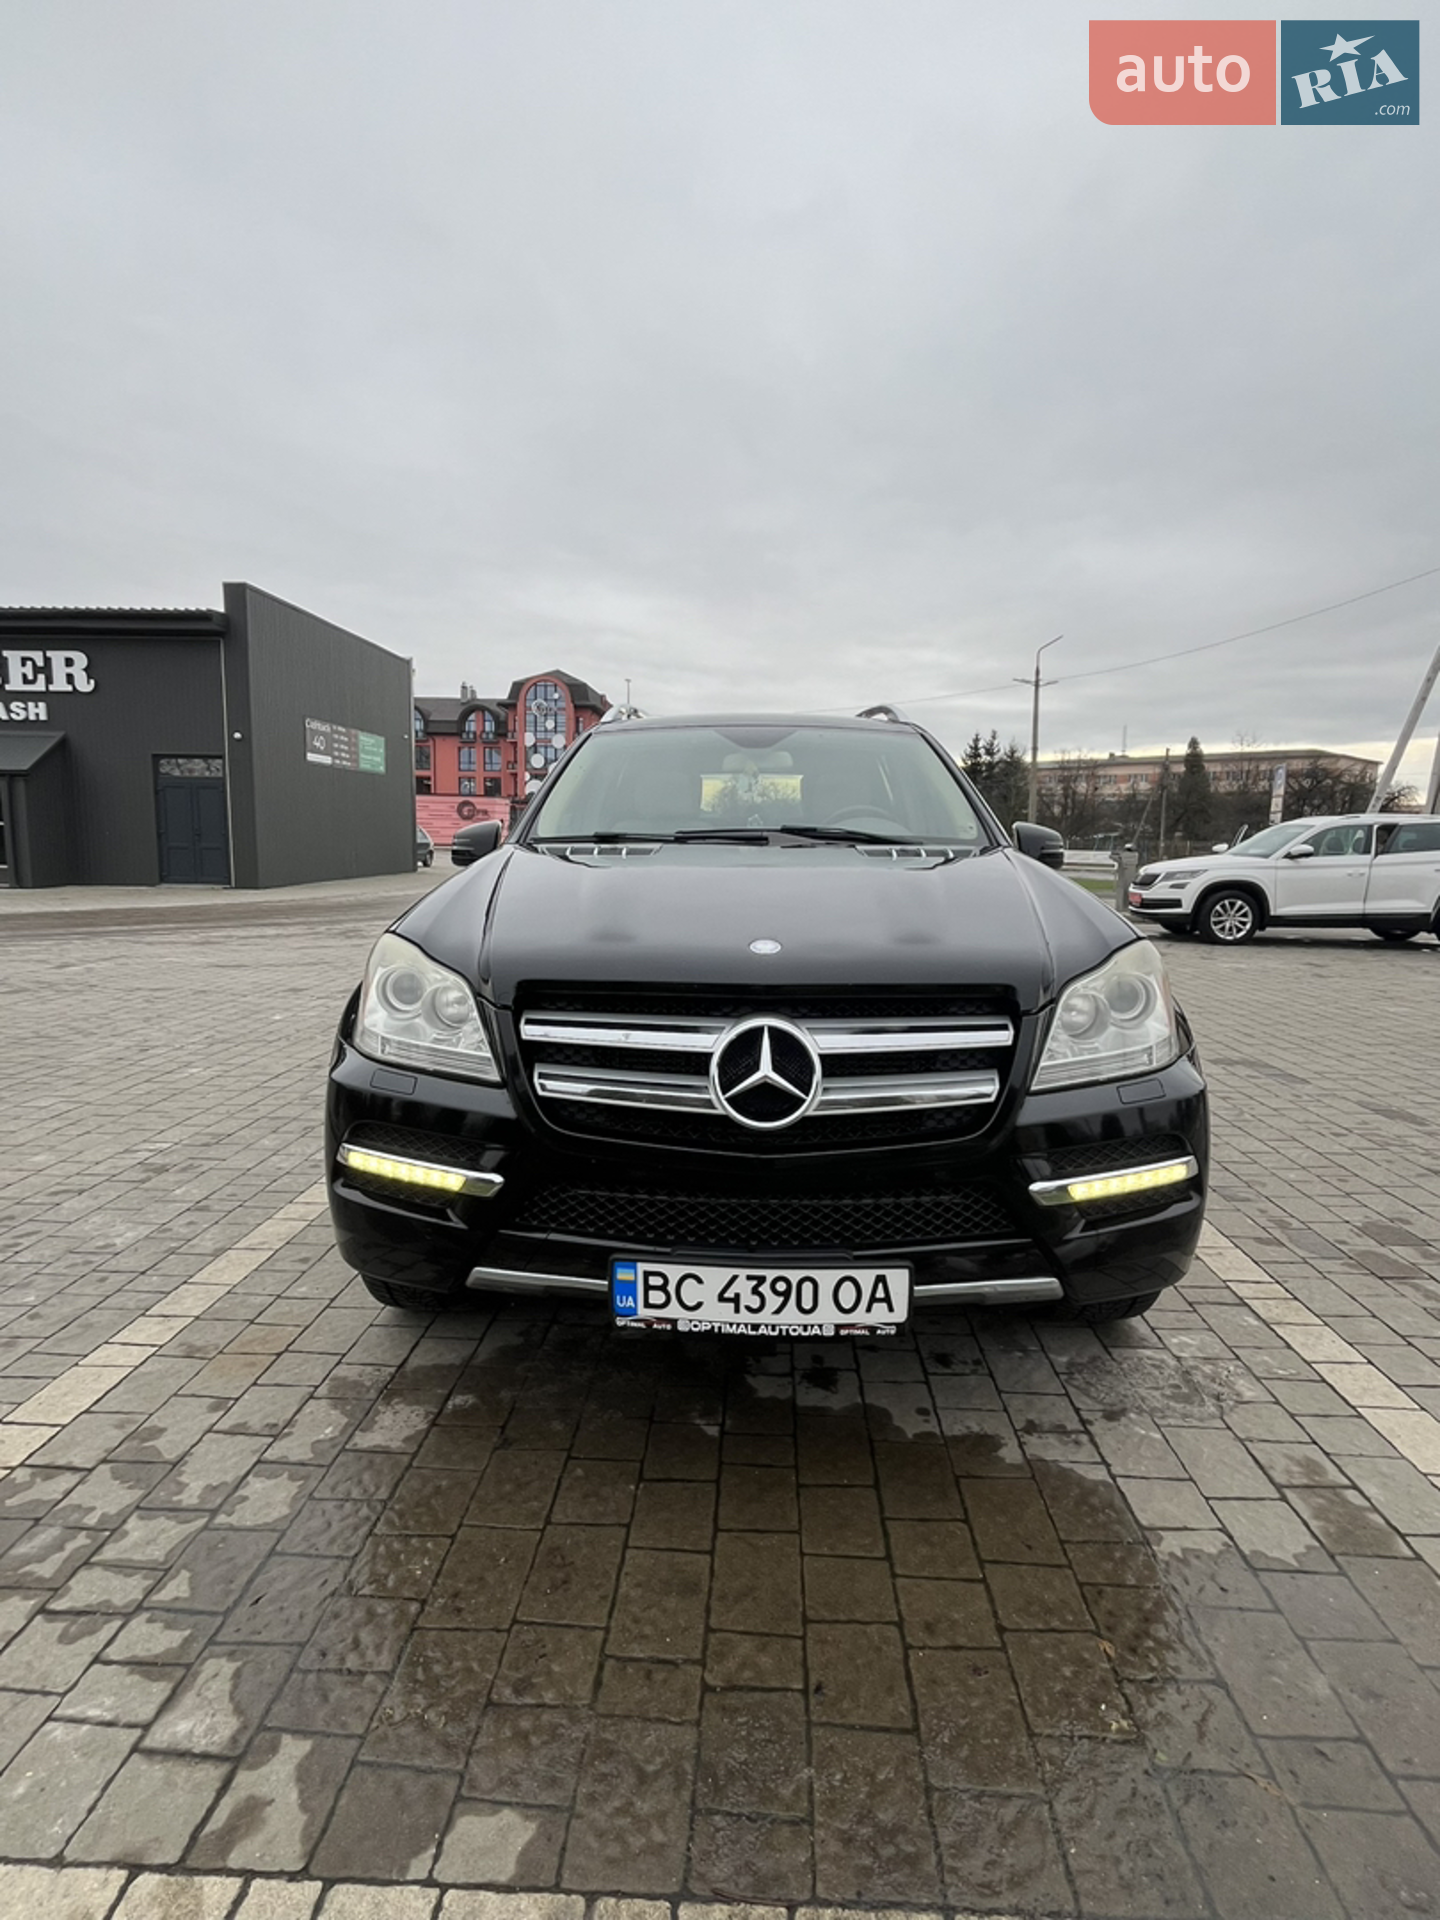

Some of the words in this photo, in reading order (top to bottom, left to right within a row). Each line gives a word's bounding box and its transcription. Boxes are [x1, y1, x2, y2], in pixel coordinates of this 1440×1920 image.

[0, 650, 95, 692] ER
[616, 1295, 635, 1308] UA
[642, 1269, 704, 1312] BC
[717, 1274, 819, 1315] 4390
[832, 1274, 895, 1315] OA
